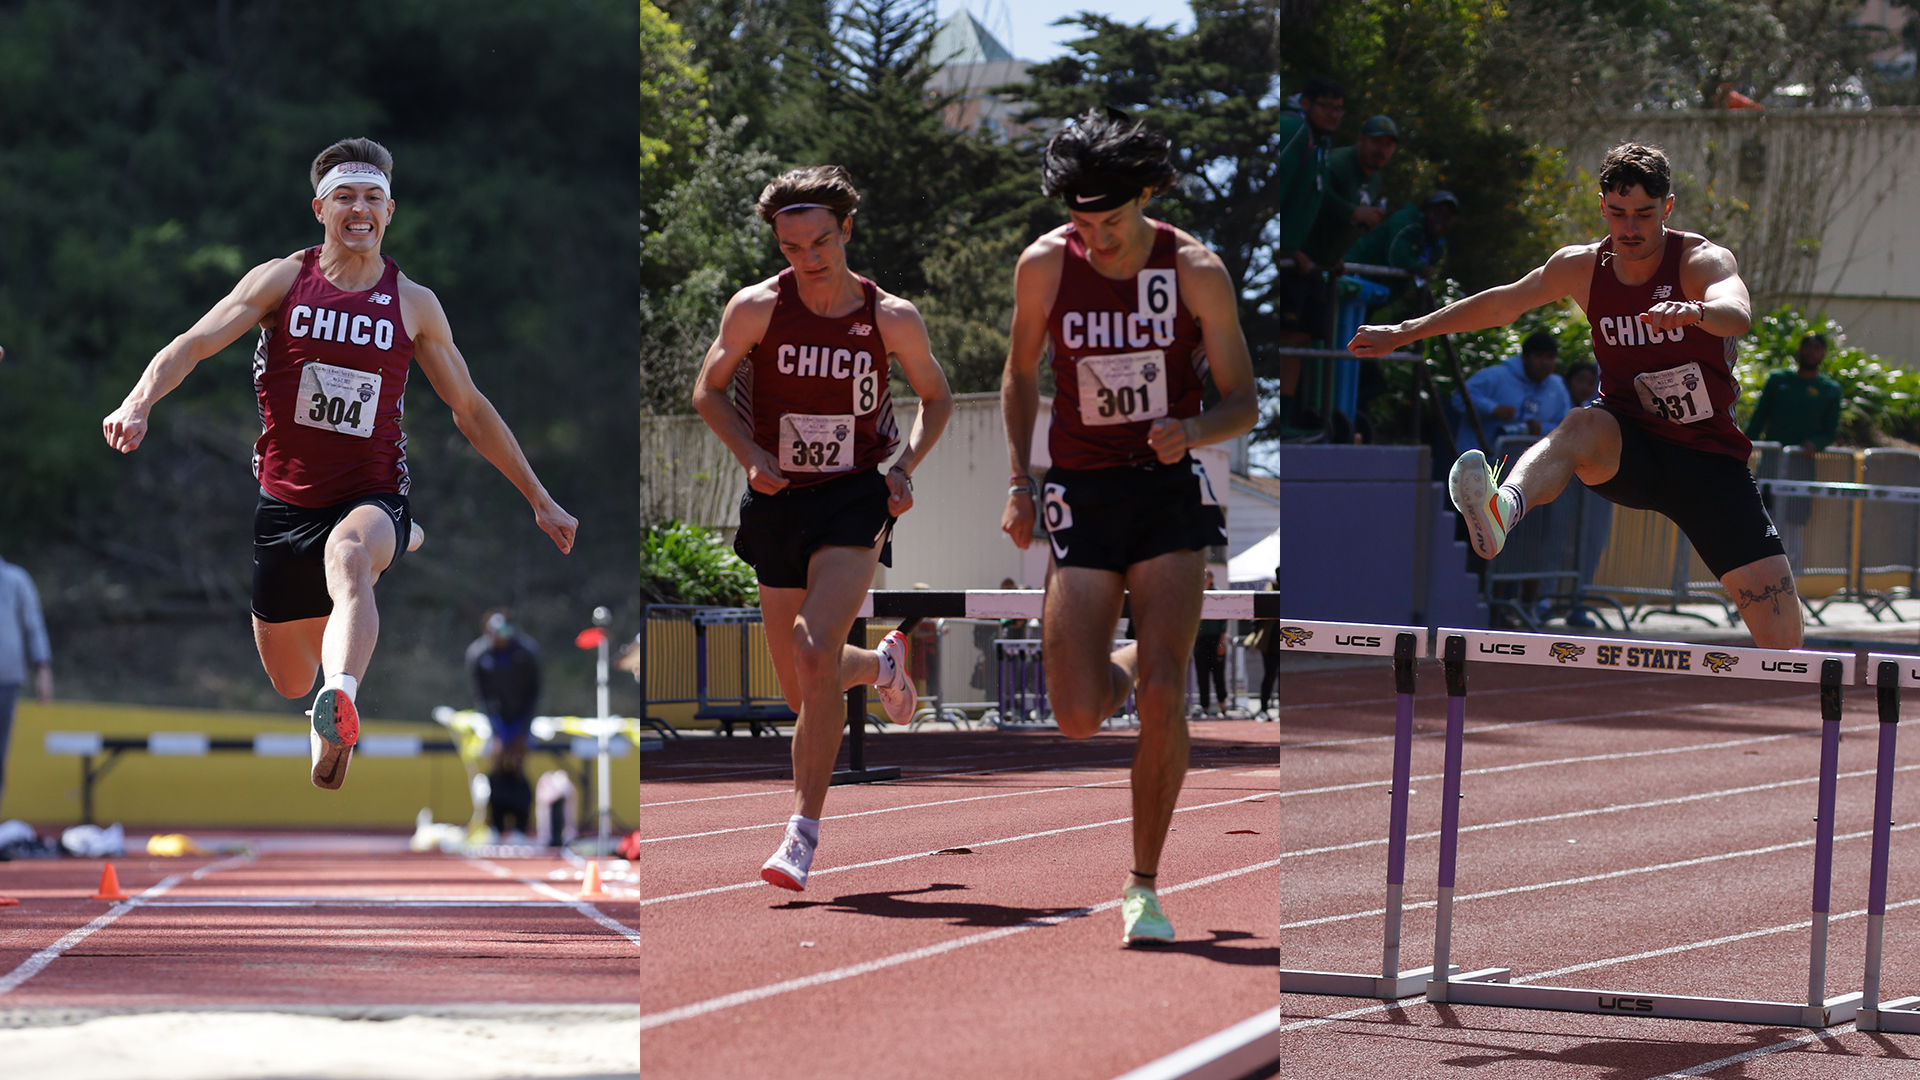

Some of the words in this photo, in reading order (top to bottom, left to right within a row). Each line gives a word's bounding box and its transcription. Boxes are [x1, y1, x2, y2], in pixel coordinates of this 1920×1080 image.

[1147, 274, 1169, 314] 6
[288, 303, 395, 352] CHICO
[1062, 311, 1176, 349] CHICO
[776, 342, 873, 380] CHICO
[859, 376, 875, 412] 8
[1097, 384, 1149, 418] 301
[1652, 391, 1697, 420] 331
[309, 393, 362, 429] 304
[792, 440, 841, 467] 332
[1335, 634, 1382, 648] UCS
[1479, 642, 1526, 656] UCS
[1597, 645, 1623, 666] SF
[1627, 647, 1692, 671] STATE
[1761, 660, 1808, 674] UCS
[1598, 996, 1654, 1012] UCS
